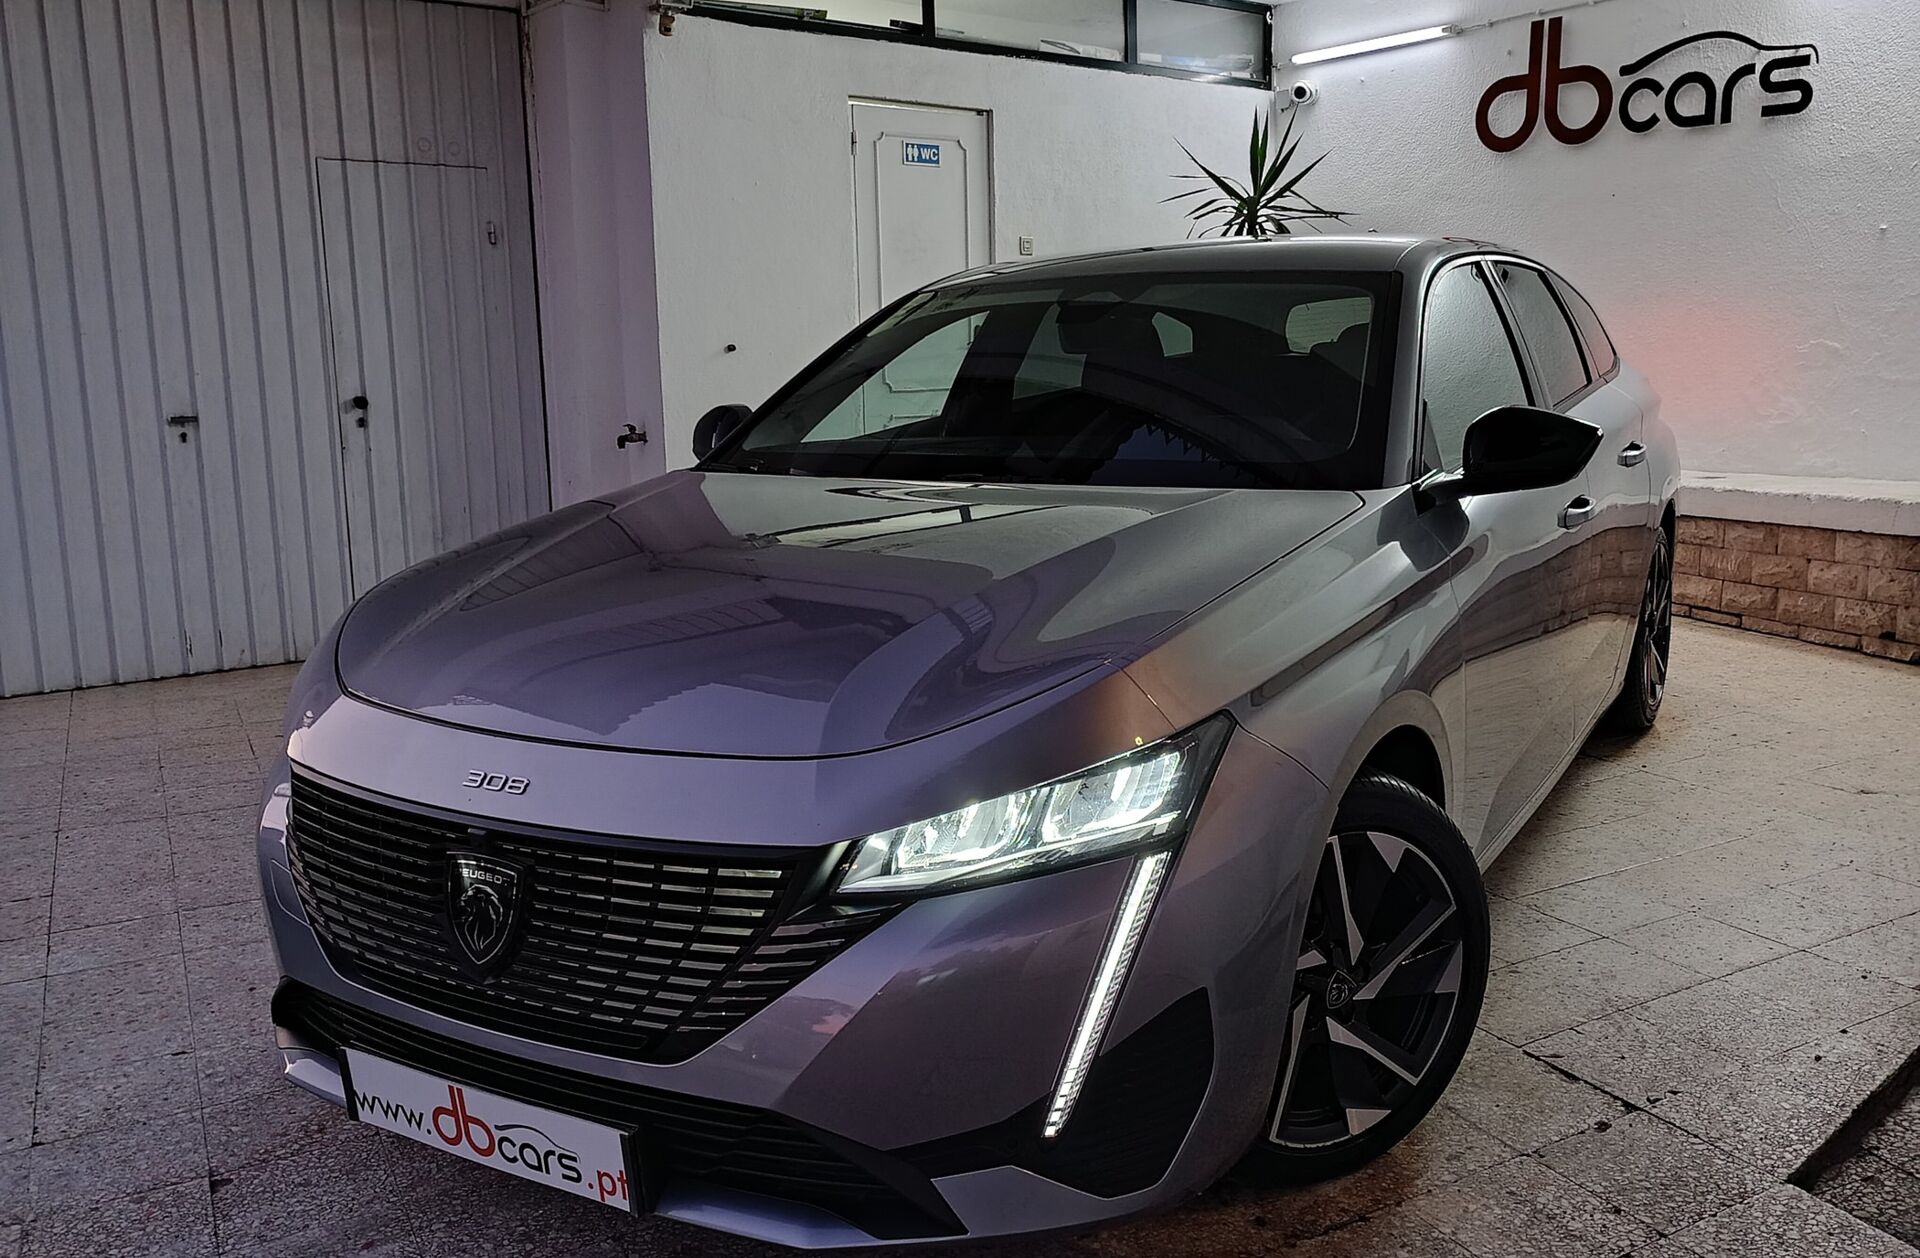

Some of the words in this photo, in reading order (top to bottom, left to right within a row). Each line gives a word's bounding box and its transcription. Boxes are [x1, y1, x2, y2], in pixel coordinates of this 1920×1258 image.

[920, 147, 938, 160] WC
[462, 769, 531, 796] 308
[457, 867, 511, 886] EUGEOT
